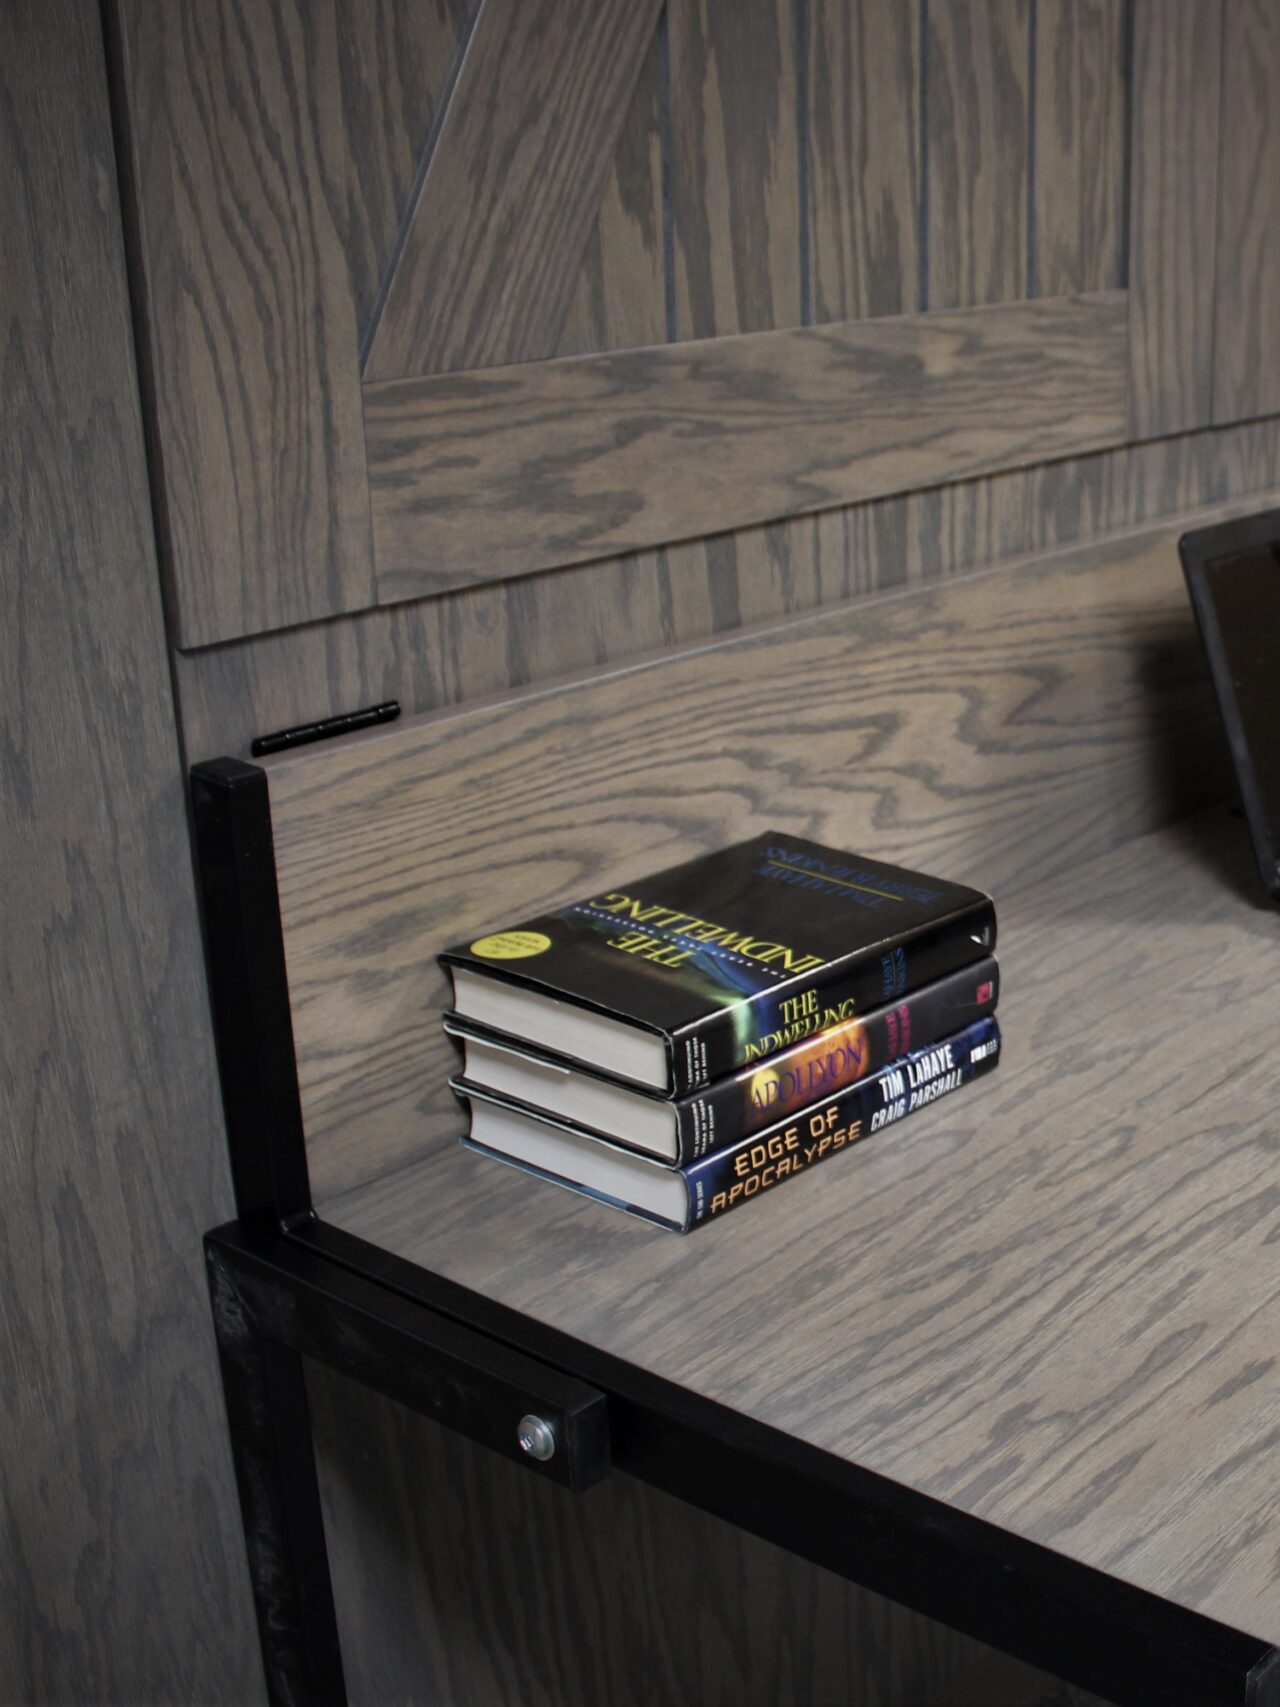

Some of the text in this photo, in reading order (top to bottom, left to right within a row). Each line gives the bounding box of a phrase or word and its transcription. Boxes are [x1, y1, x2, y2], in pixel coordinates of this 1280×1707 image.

[588, 893, 824, 974] INDWELLING
[607, 931, 695, 968] THE
[744, 997, 859, 1064] INDWELLING
[778, 988, 819, 1025] THE
[750, 1036, 866, 1117] APOLLYON
[870, 1067, 963, 1132] CRAIG PARSHALL
[879, 1069, 906, 1103] TIM
[907, 1043, 955, 1089] LAHAYE
[709, 1119, 863, 1214] APOCALYPSE
[734, 1105, 840, 1177] EDGE OF
